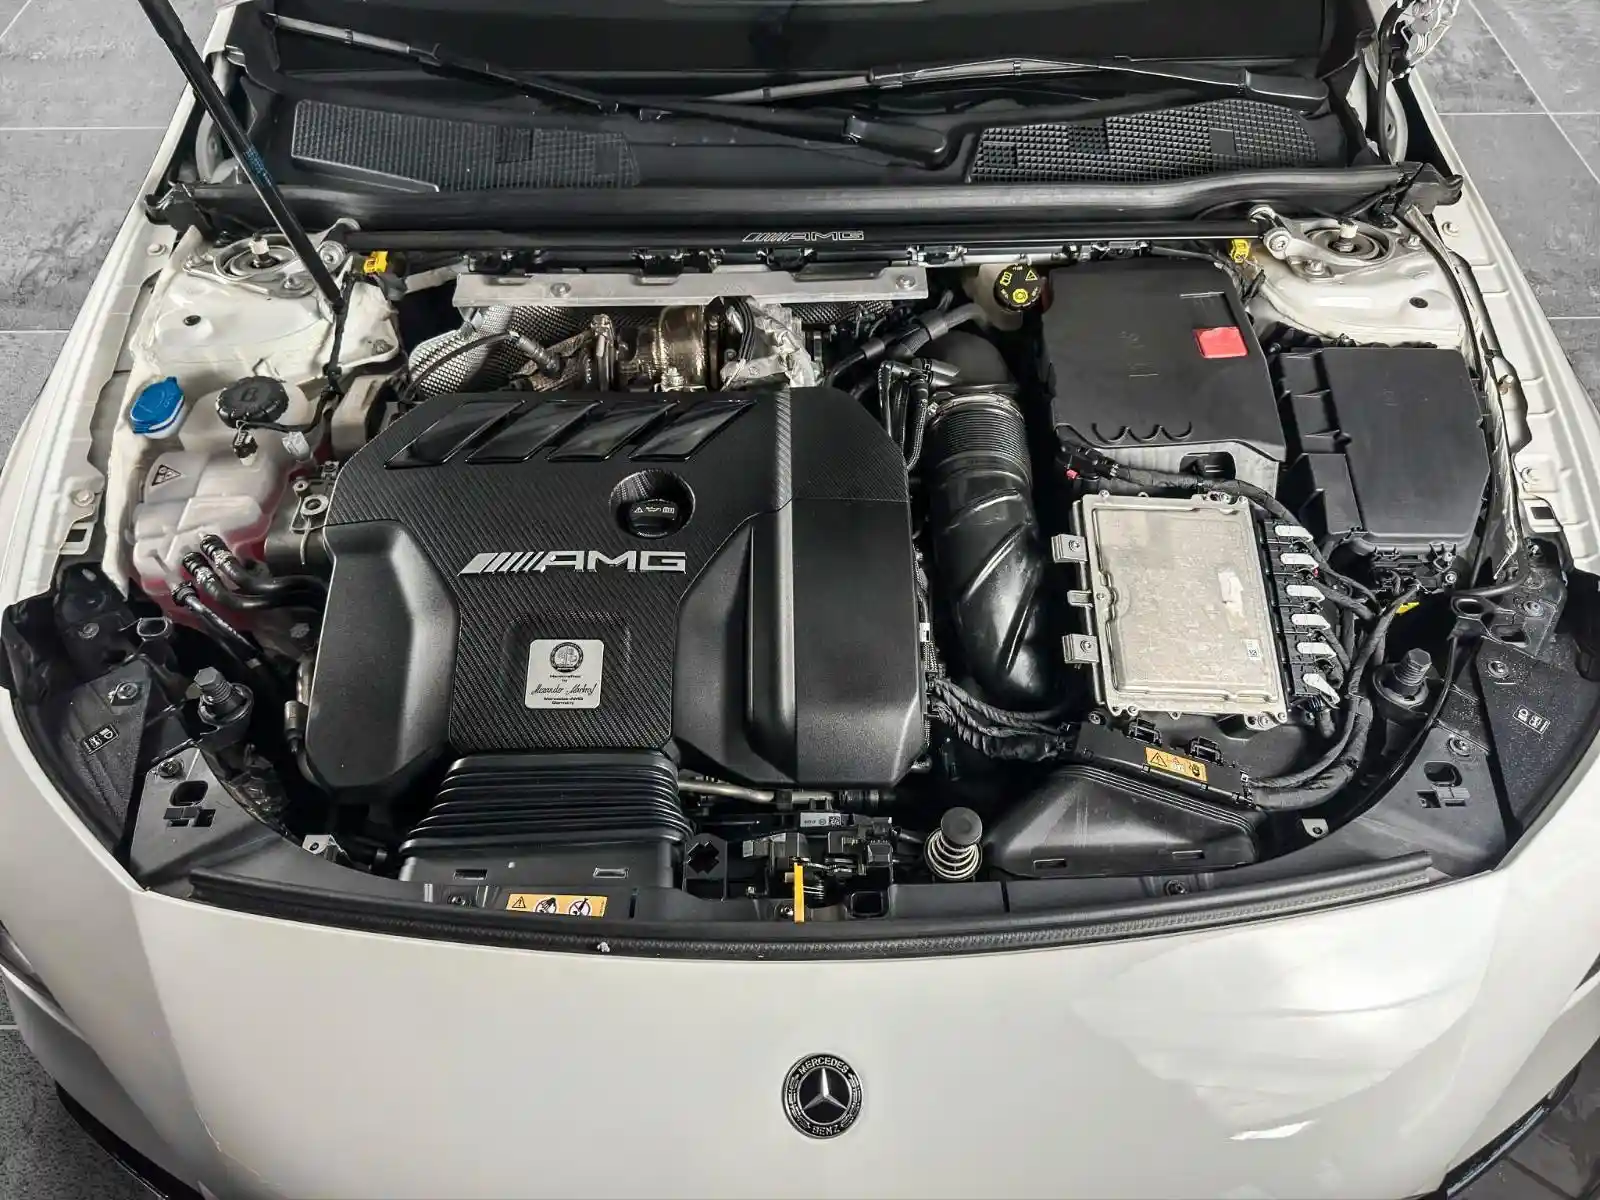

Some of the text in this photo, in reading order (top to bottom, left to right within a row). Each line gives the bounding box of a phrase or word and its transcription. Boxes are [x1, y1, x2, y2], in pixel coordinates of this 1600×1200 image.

[783, 231, 864, 242] AMG
[533, 550, 687, 573] AMG
[799, 1056, 850, 1075] MERCEDES
[811, 1124, 841, 1136] BENZ
